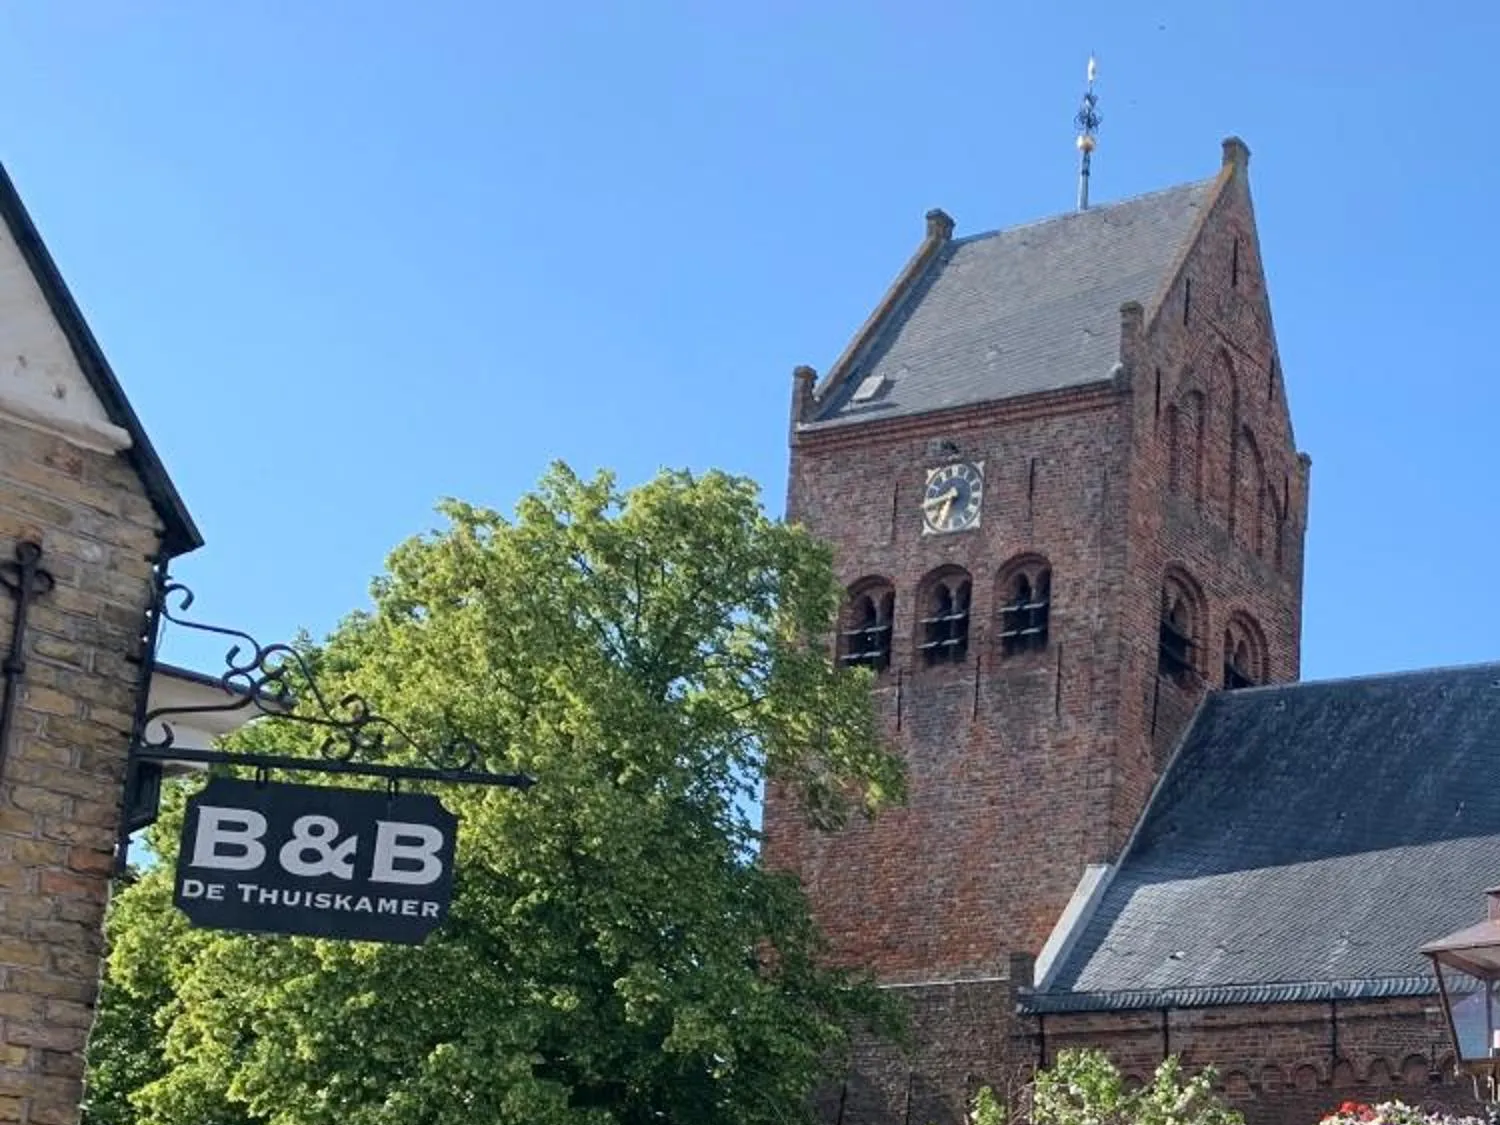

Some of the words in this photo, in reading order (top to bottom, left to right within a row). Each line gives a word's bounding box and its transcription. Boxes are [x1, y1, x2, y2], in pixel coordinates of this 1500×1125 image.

[188, 805, 444, 885] B&B
[182, 878, 224, 900] DE
[237, 883, 441, 918] THUISKAMER
